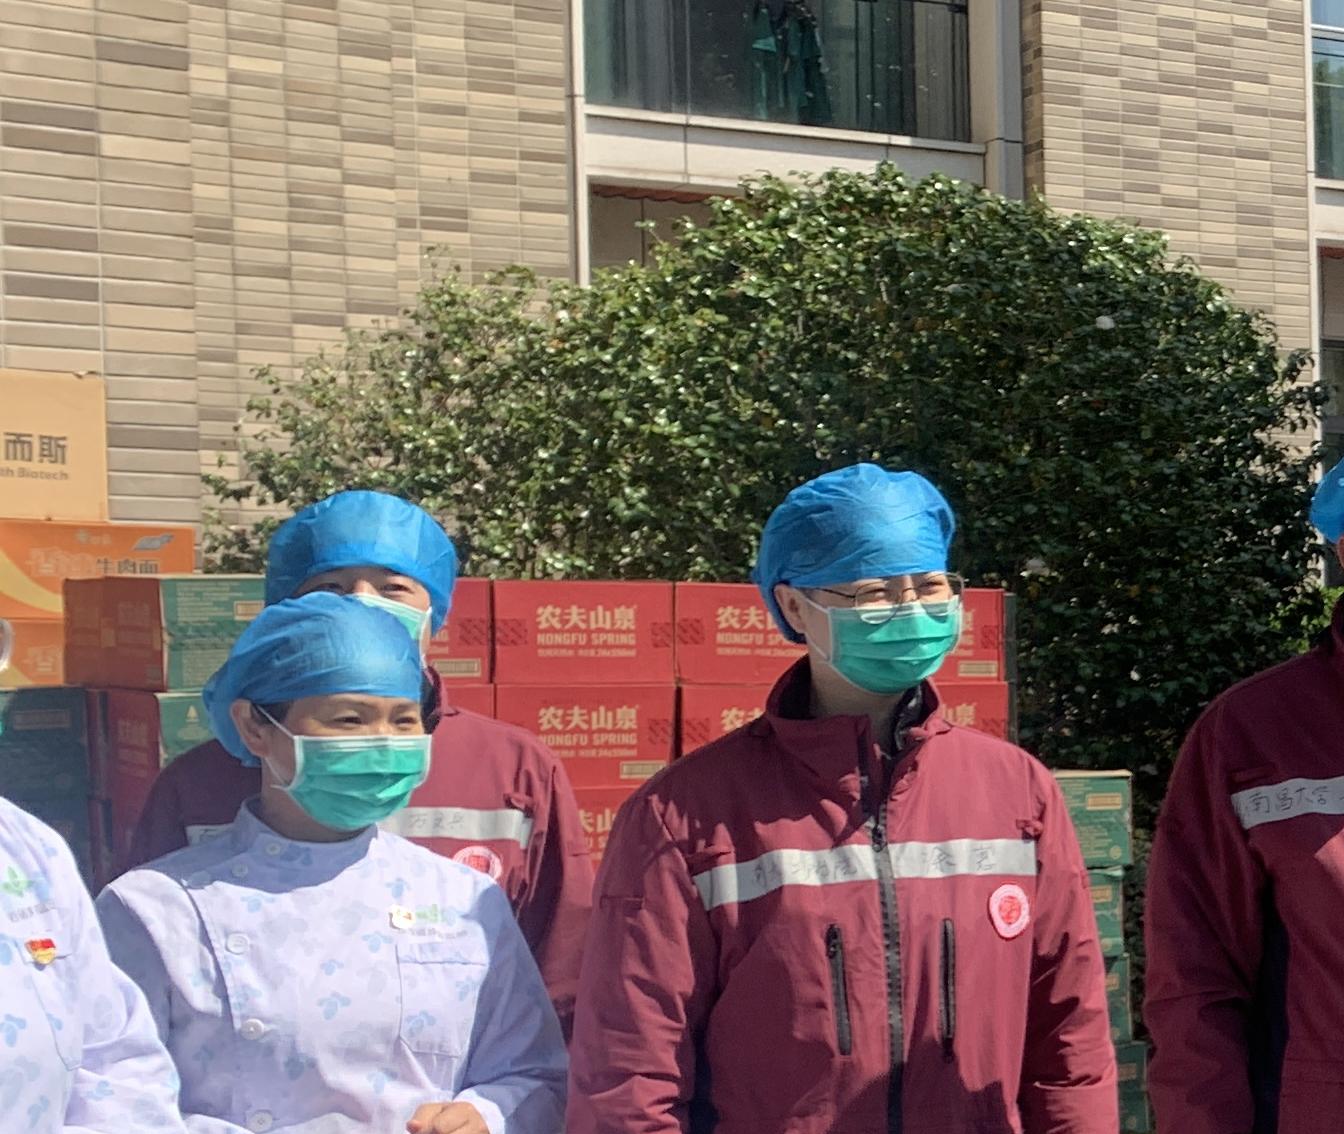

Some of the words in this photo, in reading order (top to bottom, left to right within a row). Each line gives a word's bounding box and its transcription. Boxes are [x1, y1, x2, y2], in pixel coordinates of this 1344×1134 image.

[3, 432, 68, 465] 而斯
[536, 604, 637, 630] 农夫山泉
[537, 632, 587, 646] NONGFU
[591, 633, 636, 646] SPRING
[538, 704, 639, 731] 农夫山泉
[593, 733, 637, 746] SPRING
